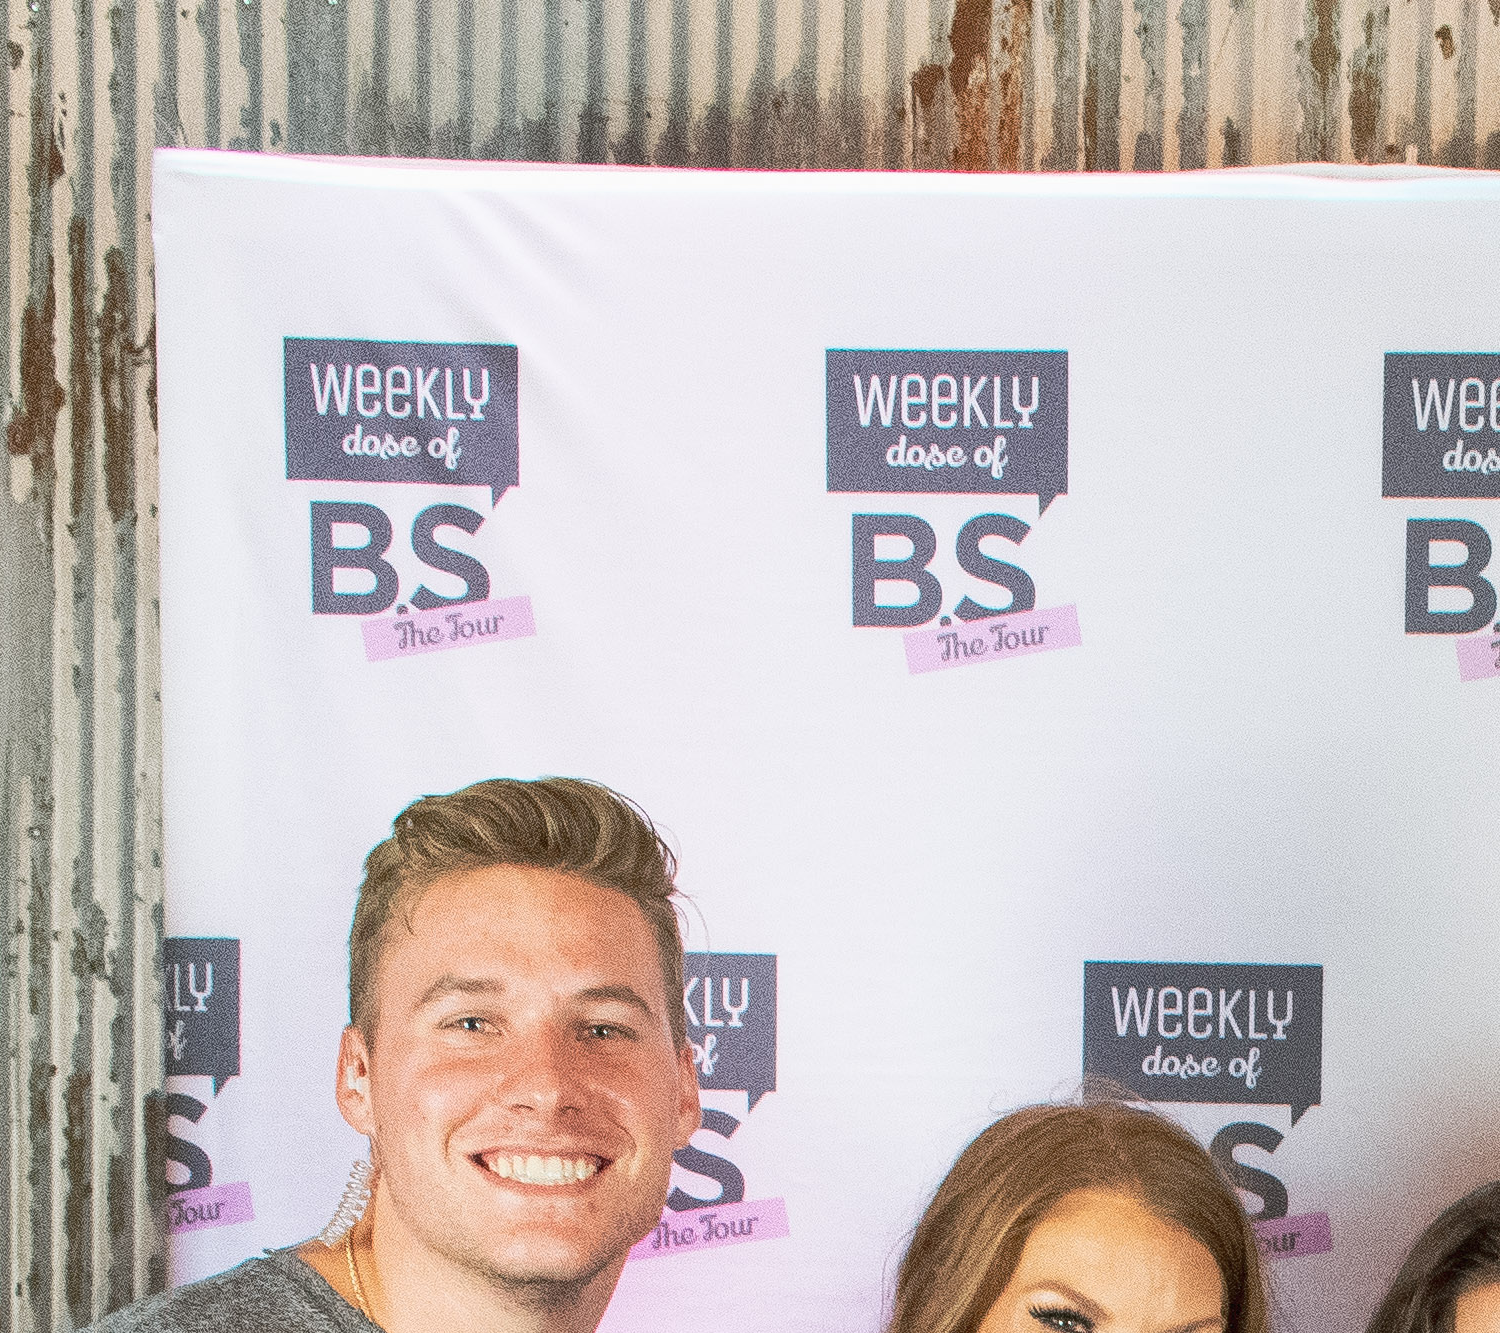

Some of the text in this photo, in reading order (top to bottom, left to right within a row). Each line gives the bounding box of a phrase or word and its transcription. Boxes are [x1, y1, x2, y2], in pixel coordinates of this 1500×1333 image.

[342, 424, 462, 470] dose of
[886, 435, 1008, 479] dose of
[394, 612, 504, 649] The Tour
[937, 623, 1049, 661] The Tour
[1141, 1045, 1262, 1089] dose of
[698, 1213, 759, 1243] Tour
